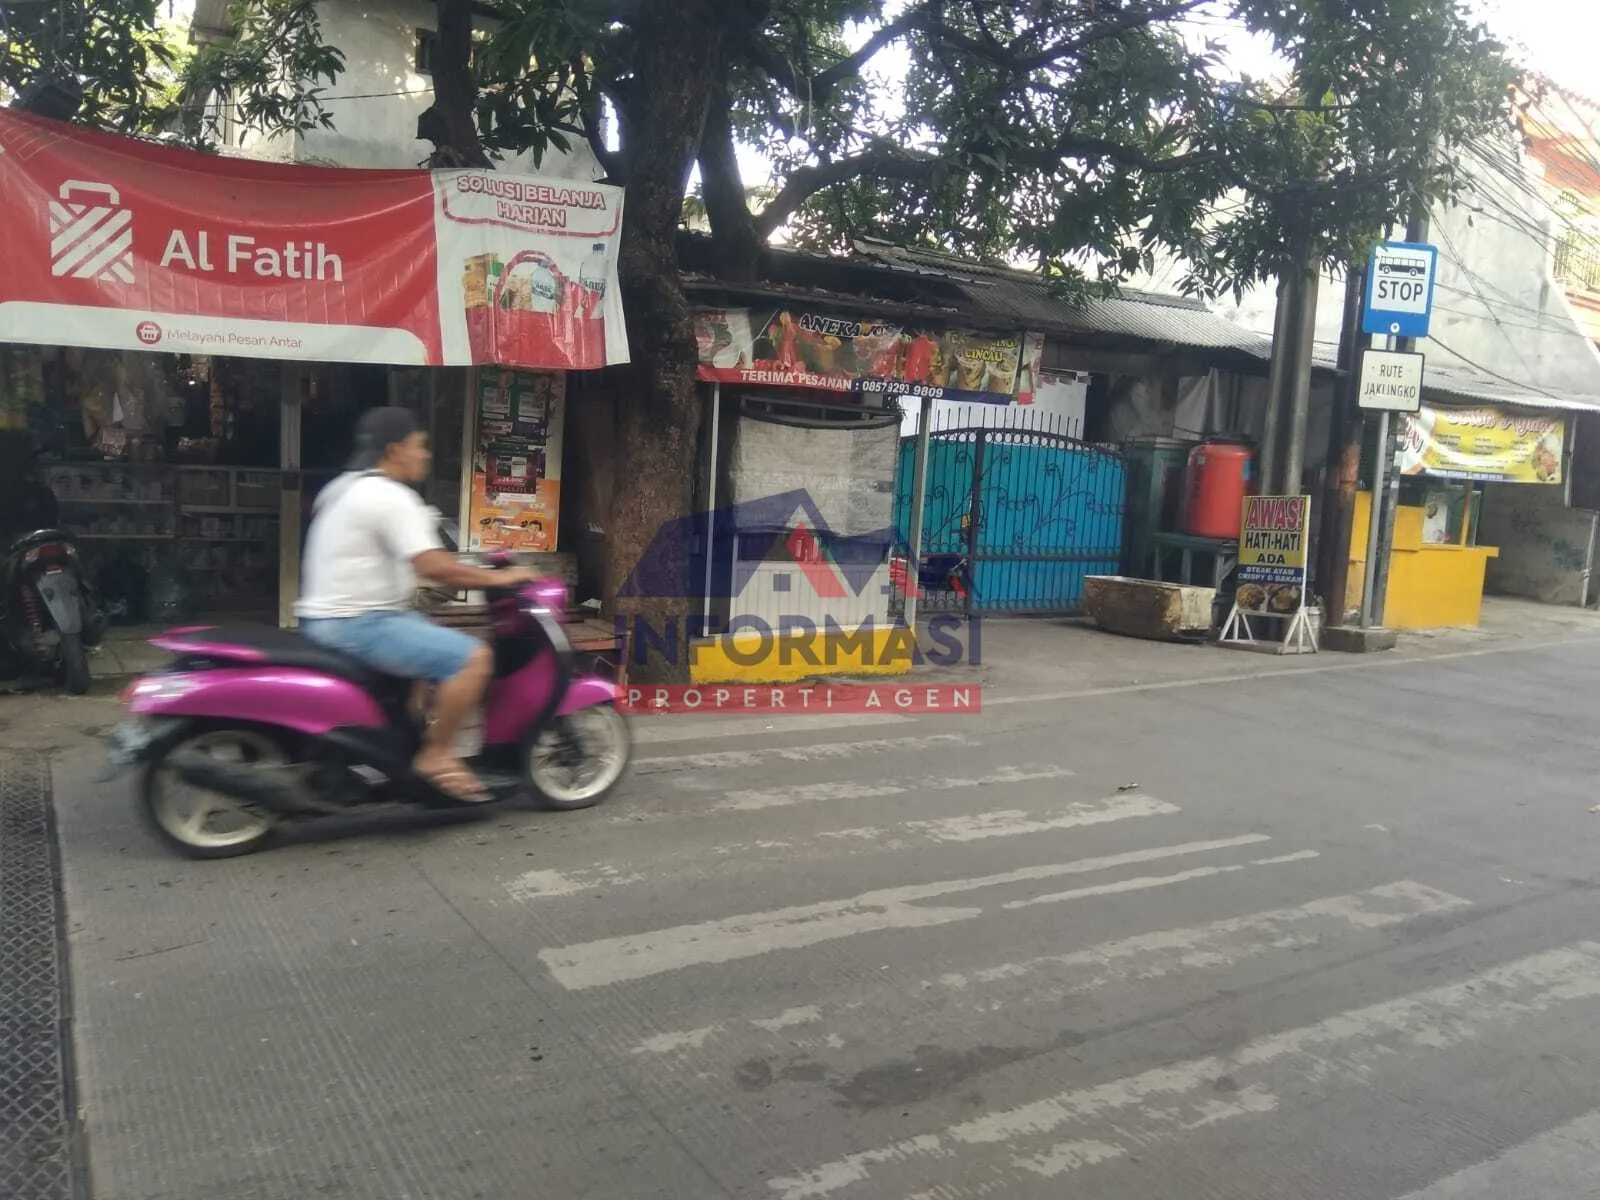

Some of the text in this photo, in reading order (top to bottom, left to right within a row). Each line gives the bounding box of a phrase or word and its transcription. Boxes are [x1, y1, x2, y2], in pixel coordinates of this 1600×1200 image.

[457, 176, 606, 210] SOLUSI BELANJA
[497, 202, 566, 228] HARIAN
[160, 229, 343, 282] Al Fatih
[1377, 279, 1424, 302] STOP
[800, 312, 862, 337] ANEKA
[167, 328, 303, 349] Melayani Pesan Antar
[740, 369, 794, 384] TERIMA
[798, 372, 853, 392] PESANAN
[913, 385, 944, 398] 9809
[1379, 363, 1404, 379] RUTE
[1364, 382, 1417, 399] JAKLINGKO
[1246, 496, 1306, 532] AWAS!
[1256, 552, 1287, 565] ADA
